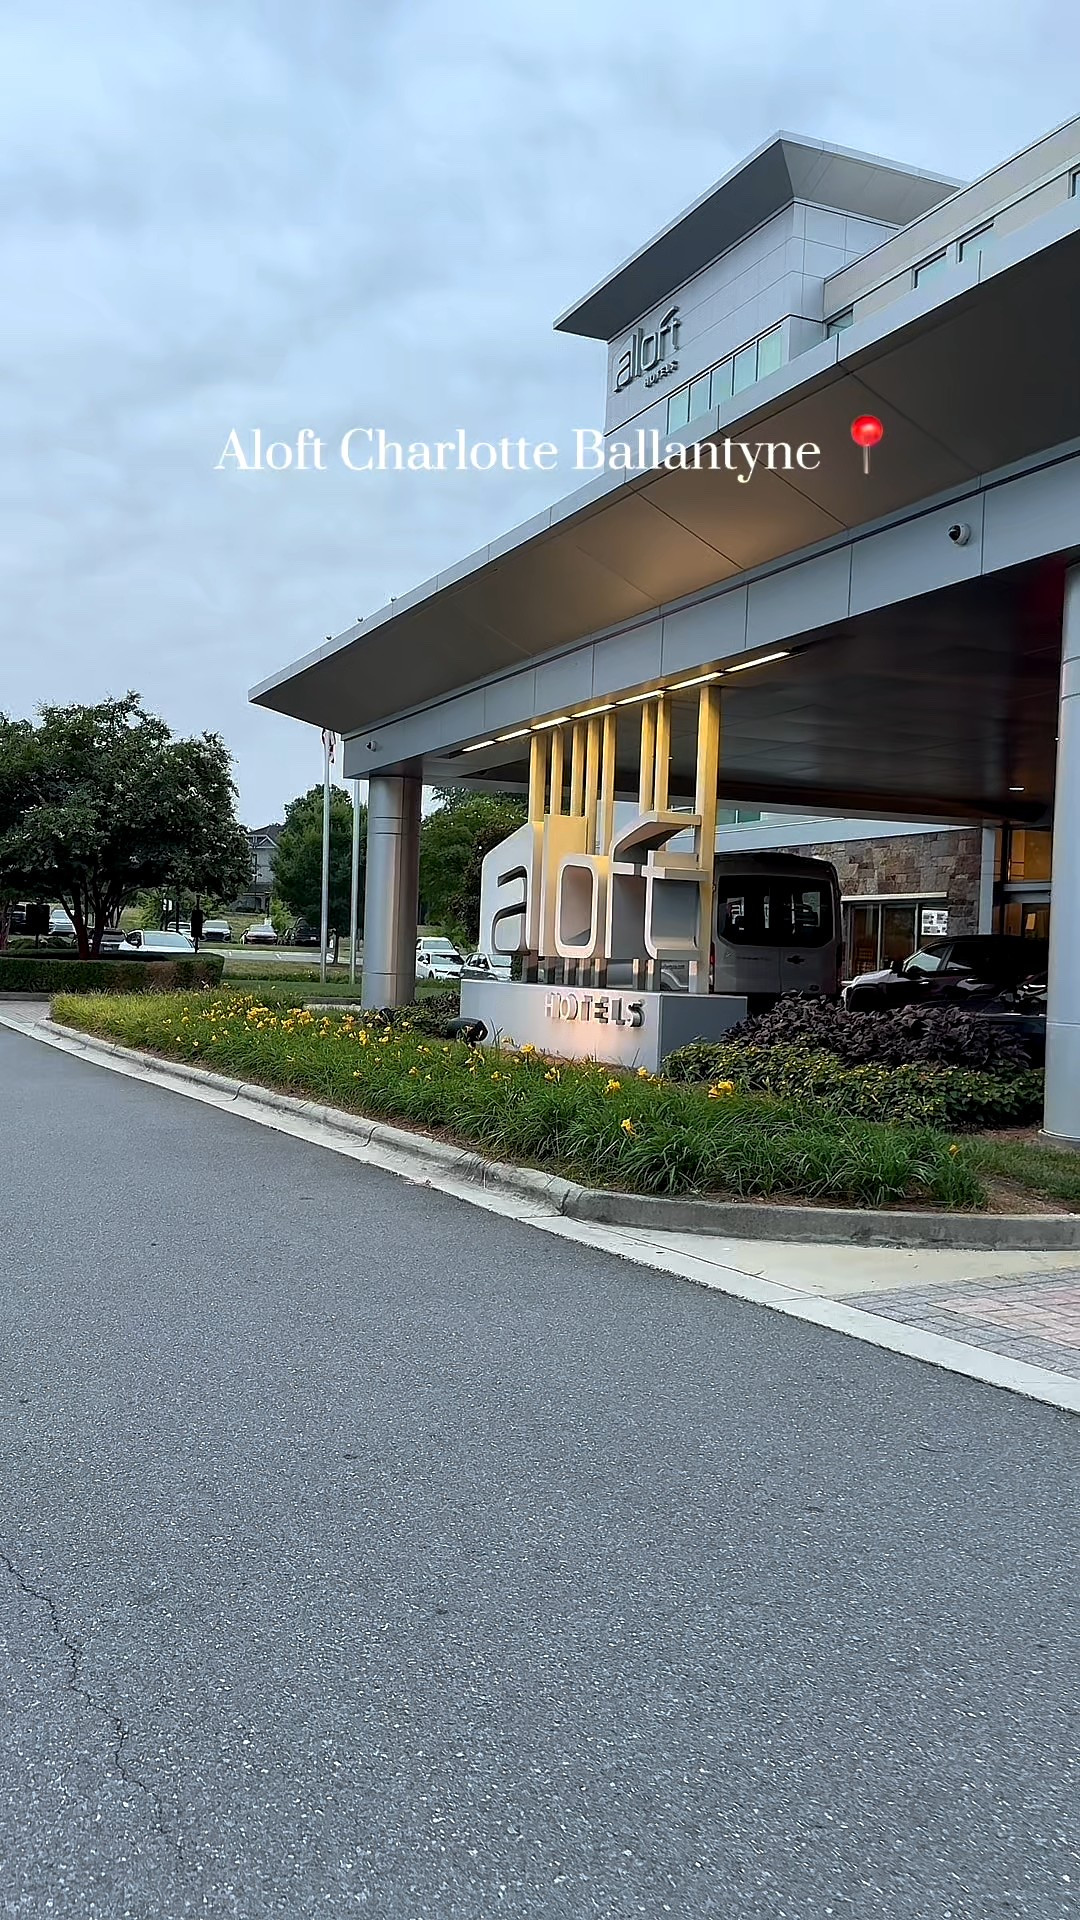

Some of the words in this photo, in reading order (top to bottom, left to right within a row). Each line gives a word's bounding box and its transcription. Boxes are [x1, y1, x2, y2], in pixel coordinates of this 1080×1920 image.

[613, 305, 681, 393] aloft
[481, 810, 709, 960] aloft
[544, 992, 646, 1028] HOTELS
